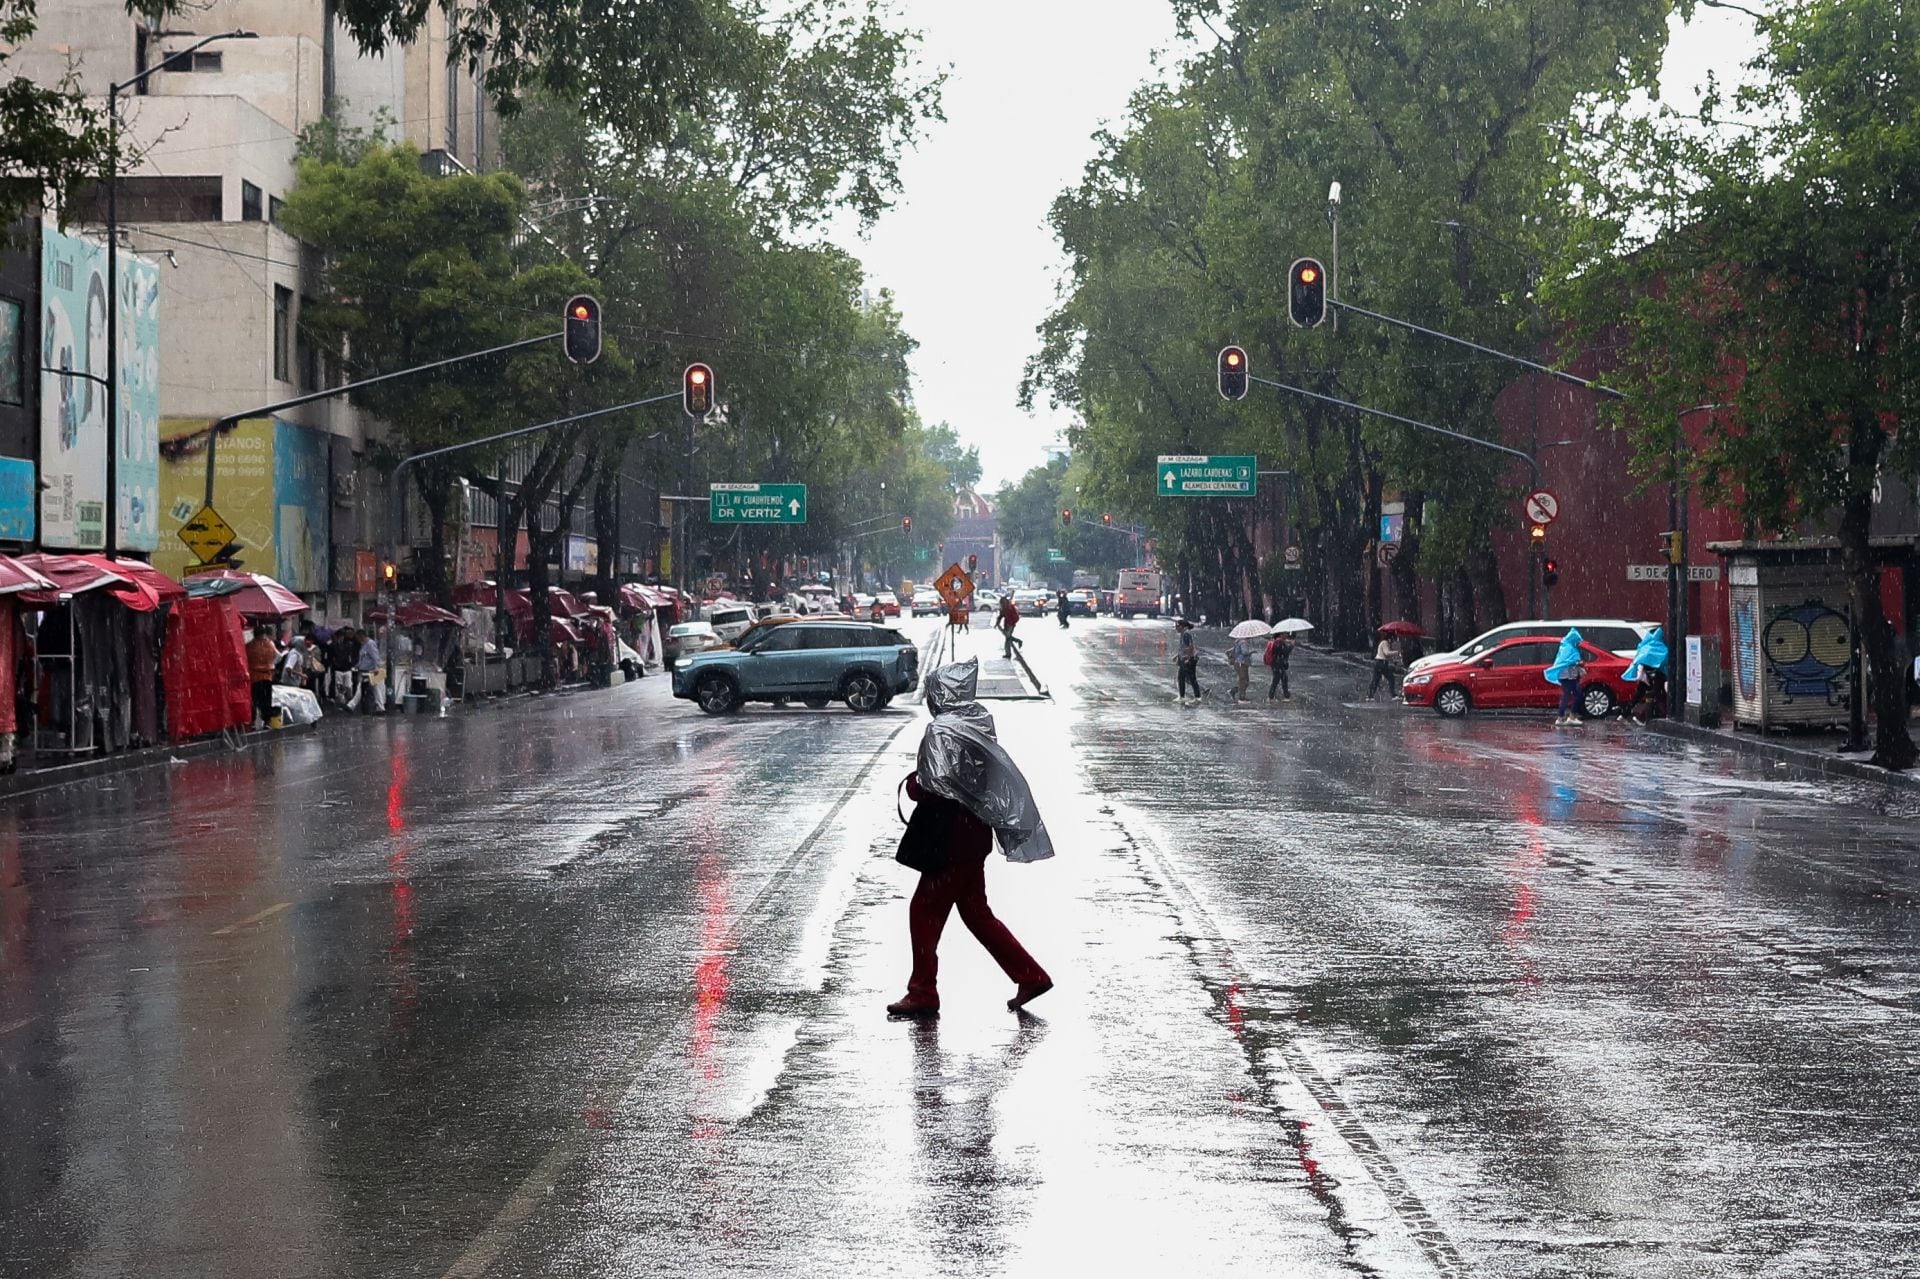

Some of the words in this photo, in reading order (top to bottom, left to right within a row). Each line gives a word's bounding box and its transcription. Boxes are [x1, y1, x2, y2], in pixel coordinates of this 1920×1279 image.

[1180, 468, 1203, 478] LAZARO
[1204, 468, 1233, 478] CARDENAS
[1185, 482, 1211, 490] ALAMEDA
[1212, 482, 1238, 490] CENTRAL
[733, 495, 741, 505] AV
[743, 495, 785, 506] CUAUHTEMOC
[718, 508, 735, 518] DR
[740, 508, 782, 518] VERTIZ
[1634, 567, 1641, 578] 5
[1646, 567, 1659, 578] DE
